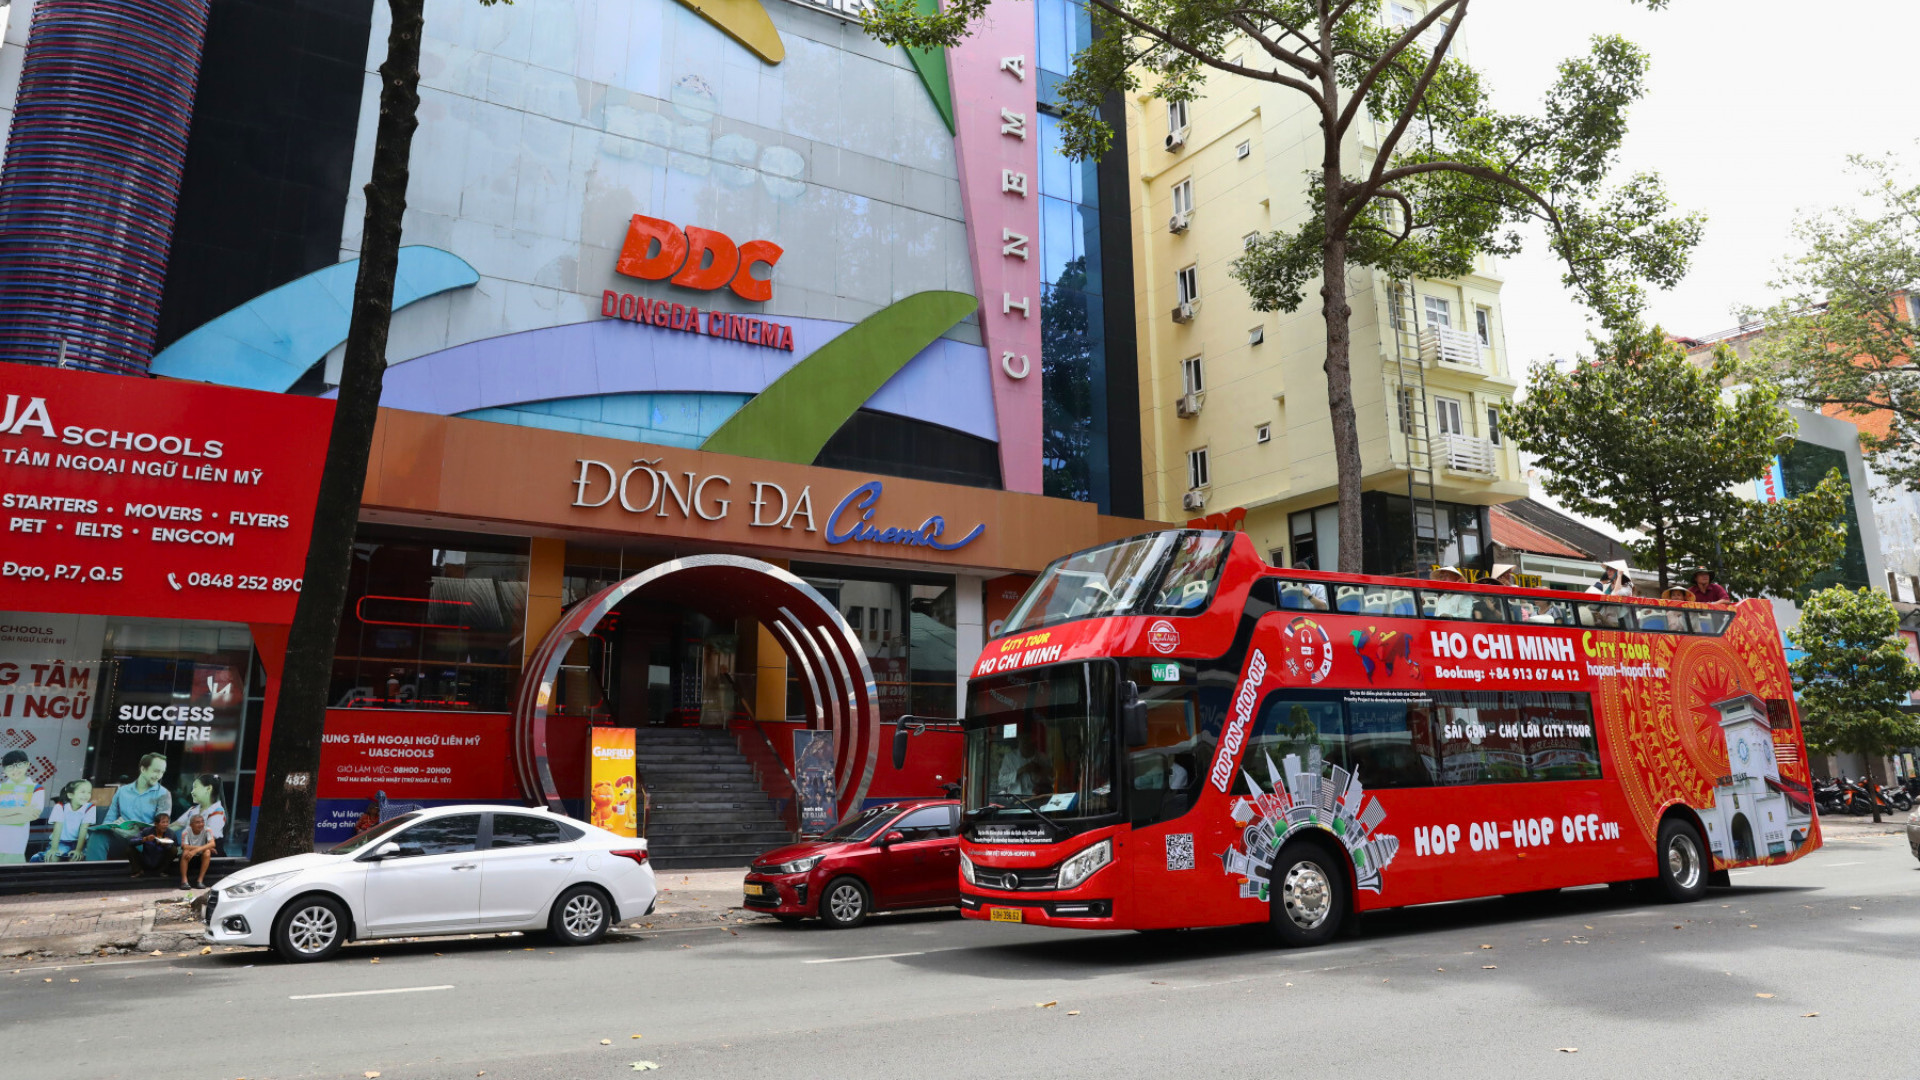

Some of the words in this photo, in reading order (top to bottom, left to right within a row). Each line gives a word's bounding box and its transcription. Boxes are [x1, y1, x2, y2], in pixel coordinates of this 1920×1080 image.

[1000, 54, 1030, 380] CINEMA
[615, 214, 784, 302] DDC
[601, 289, 700, 334] DONGDA
[708, 311, 795, 352] CINEMA
[62, 426, 224, 459] SCHOOLS
[2, 446, 50, 468] TÂM
[56, 454, 125, 475] NGOẠI
[132, 460, 179, 478] NGỮ
[182, 464, 228, 482] LIÊN
[234, 468, 264, 486] MỸ
[571, 456, 731, 522] ĐỐNG
[749, 481, 818, 532] ĐA
[2, 492, 99, 514] STARTERS
[125, 502, 203, 522] MOVERS
[229, 510, 289, 529] FLYERS
[824, 481, 987, 551] Cinema
[9, 517, 47, 534] PET
[75, 521, 124, 539] IELTS
[151, 526, 235, 547] ENGCOM
[187, 571, 234, 588] 0848
[238, 575, 269, 591] 252
[1001, 638, 1025, 653] CITY
[1025, 632, 1052, 647] TOUR
[1430, 631, 1468, 659] HO
[1472, 633, 1514, 660] CHI
[1517, 635, 1576, 662] MINH
[1619, 642, 1651, 660] TOUR
[30, 659, 91, 690] TÂM
[978, 657, 997, 676] HO
[997, 652, 1023, 671] CHI
[1022, 644, 1063, 666] MINH
[1435, 665, 1486, 683] Booking:
[1488, 667, 1510, 680] +84
[1512, 668, 1533, 681] 913
[1535, 668, 1548, 680] 67
[1551, 669, 1564, 681] 44
[1566, 670, 1580, 682] 12
[1586, 660, 1666, 681] hopon-hopoff.vn
[22, 691, 91, 720] NGỮ
[118, 705, 215, 722] SUCCESS
[1211, 747, 1234, 793] HOP
[1248, 648, 1267, 687] OFF
[117, 724, 158, 734] starts
[159, 725, 212, 741] HERE
[322, 734, 350, 744] RUNG
[353, 733, 375, 744] TÂM
[377, 735, 414, 746] NGOẠI
[416, 734, 440, 745] NGỮ
[441, 735, 463, 746] LIÊN
[465, 734, 481, 746] MỸ
[1444, 720, 1462, 739] SÀI
[1465, 721, 1487, 739] GÒN
[1543, 723, 1564, 739] CITY
[1566, 723, 1592, 739] TOUR
[368, 748, 434, 758] UASCHOOLS
[285, 774, 306, 786] 482
[1414, 824, 1461, 857] HOP
